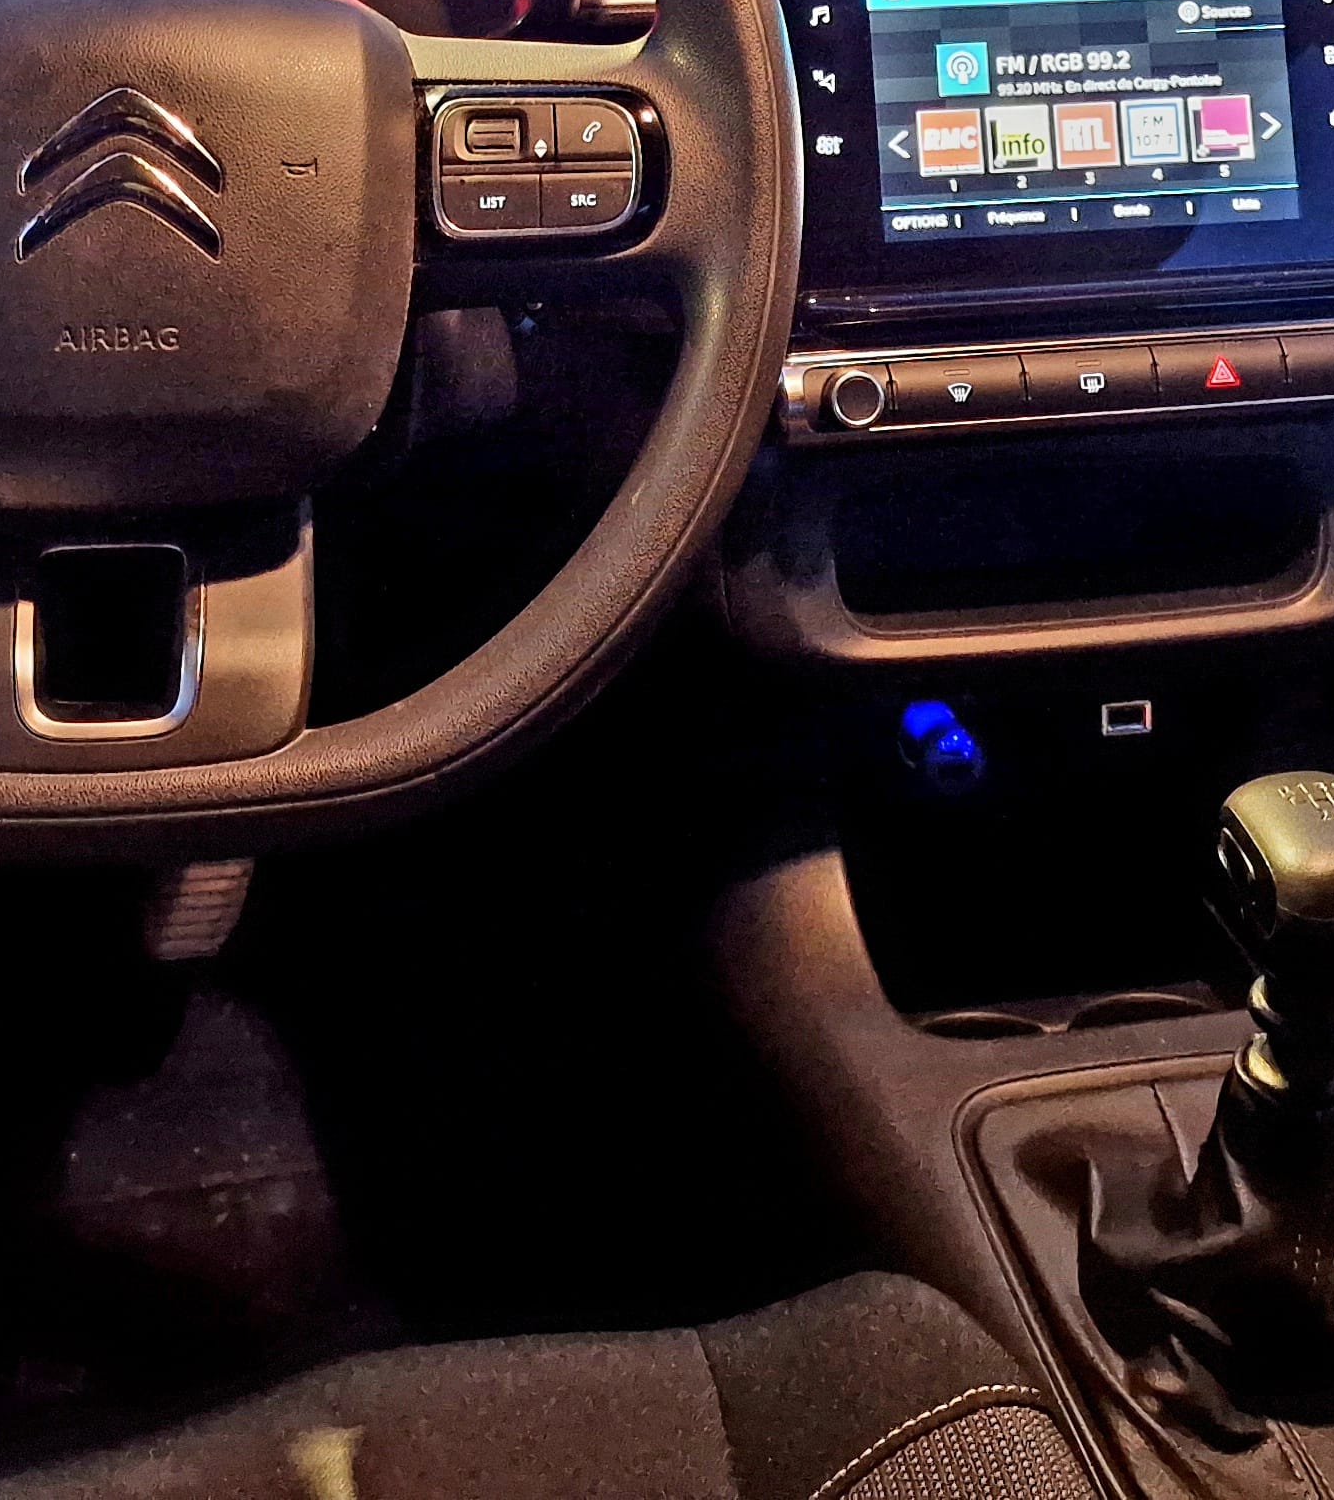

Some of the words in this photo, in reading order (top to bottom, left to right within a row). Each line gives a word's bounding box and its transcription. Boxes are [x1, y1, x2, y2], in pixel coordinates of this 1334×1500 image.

[1201, 4, 1253, 20] Sources
[995, 55, 1026, 76] FM
[1028, 54, 1039, 76] /
[1040, 52, 1084, 73] RGB
[1086, 49, 1132, 71] 99.2
[1033, 81, 1064, 96] MHz
[1083, 79, 1116, 93] direct
[1117, 77, 1134, 92] de
[1142, 115, 1163, 127] FM
[923, 126, 979, 151] RMC
[1061, 118, 1112, 152] RTL
[1001, 132, 1046, 158] info
[1017, 175, 1028, 190] 2
[1084, 171, 1097, 186] 3
[1151, 167, 1165, 181] 4
[479, 195, 507, 210] LIST
[570, 193, 597, 207] SRC
[890, 213, 950, 231] OPTIONS
[53, 325, 181, 353] AIRBAG
